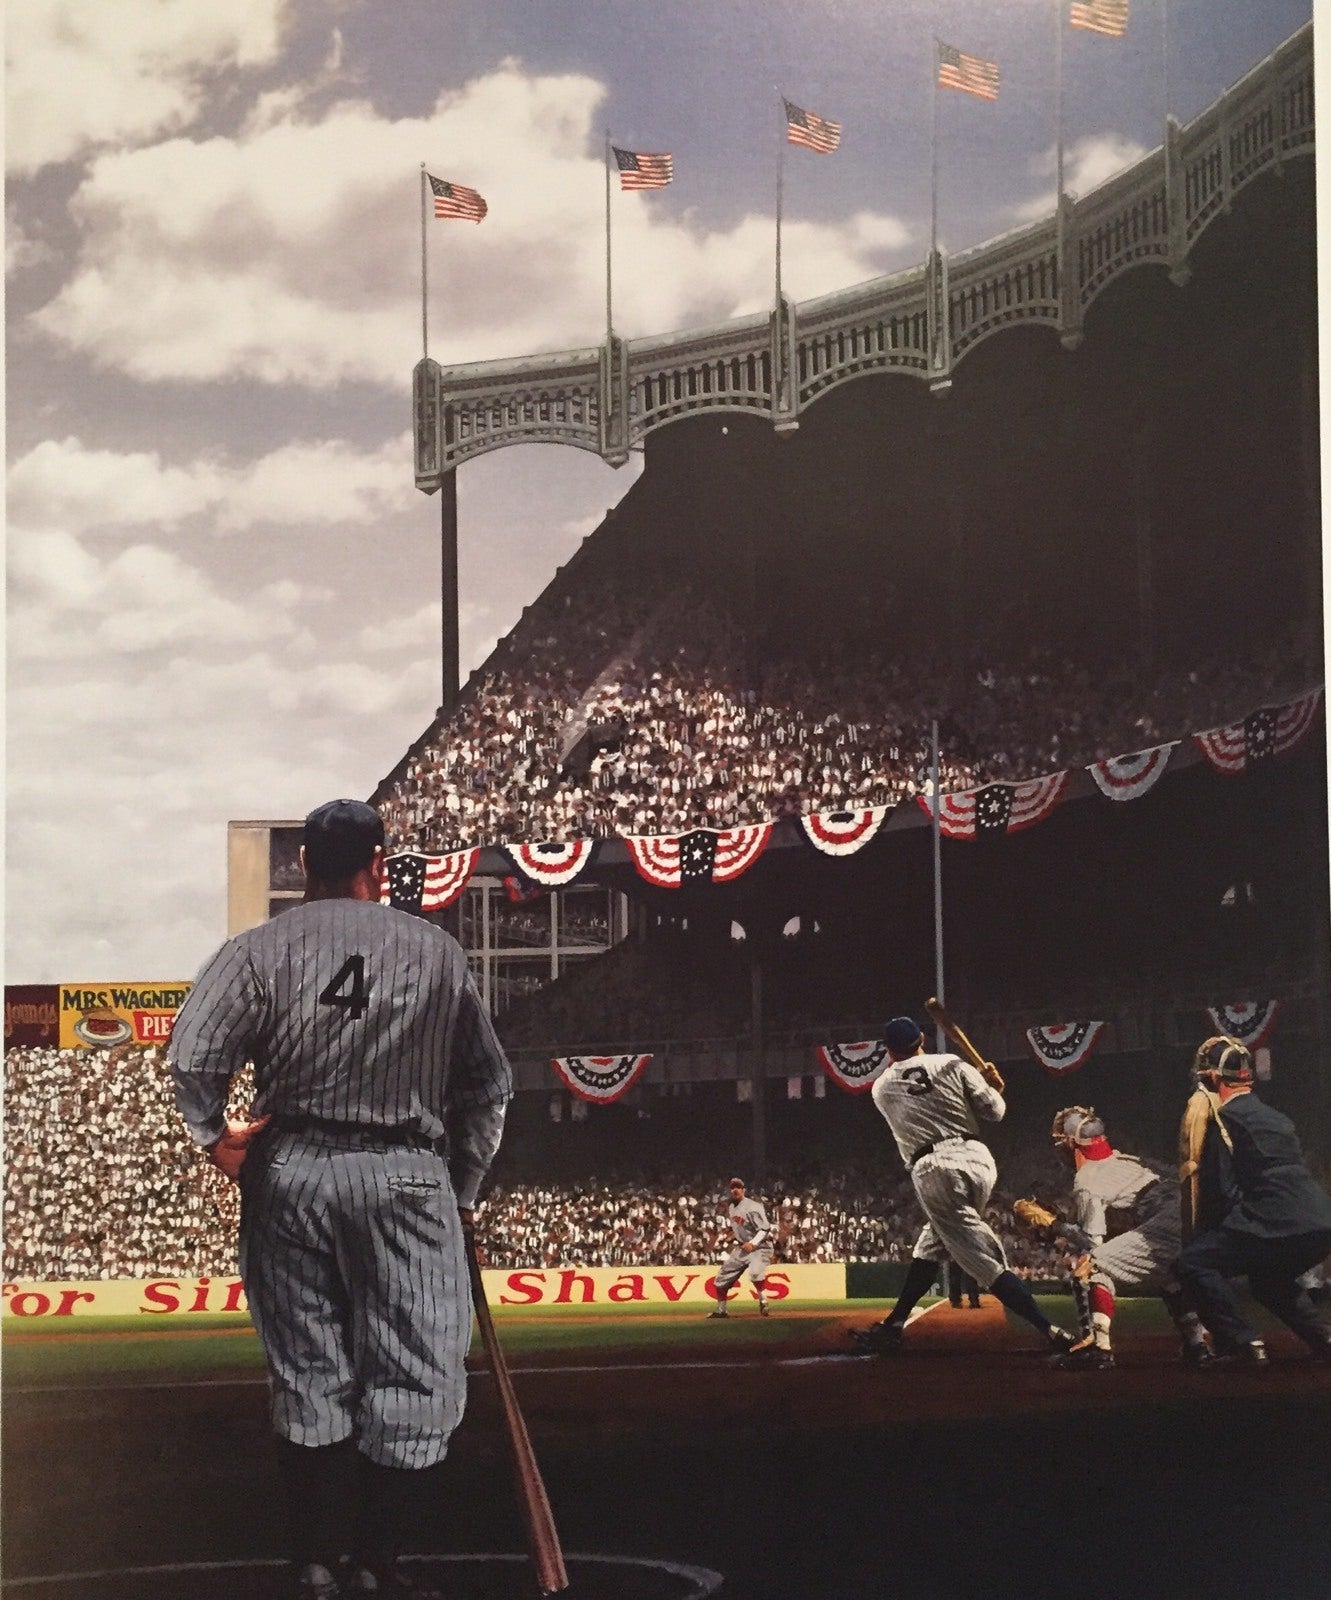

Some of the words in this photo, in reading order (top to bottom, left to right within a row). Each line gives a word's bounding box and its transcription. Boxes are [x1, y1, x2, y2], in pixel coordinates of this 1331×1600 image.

[62, 989, 107, 1010] MRS
[319, 955, 369, 1020] 4
[142, 1016, 175, 1037] PIE
[902, 1066, 933, 1096] 3
[500, 1270, 791, 1304] Shaves
